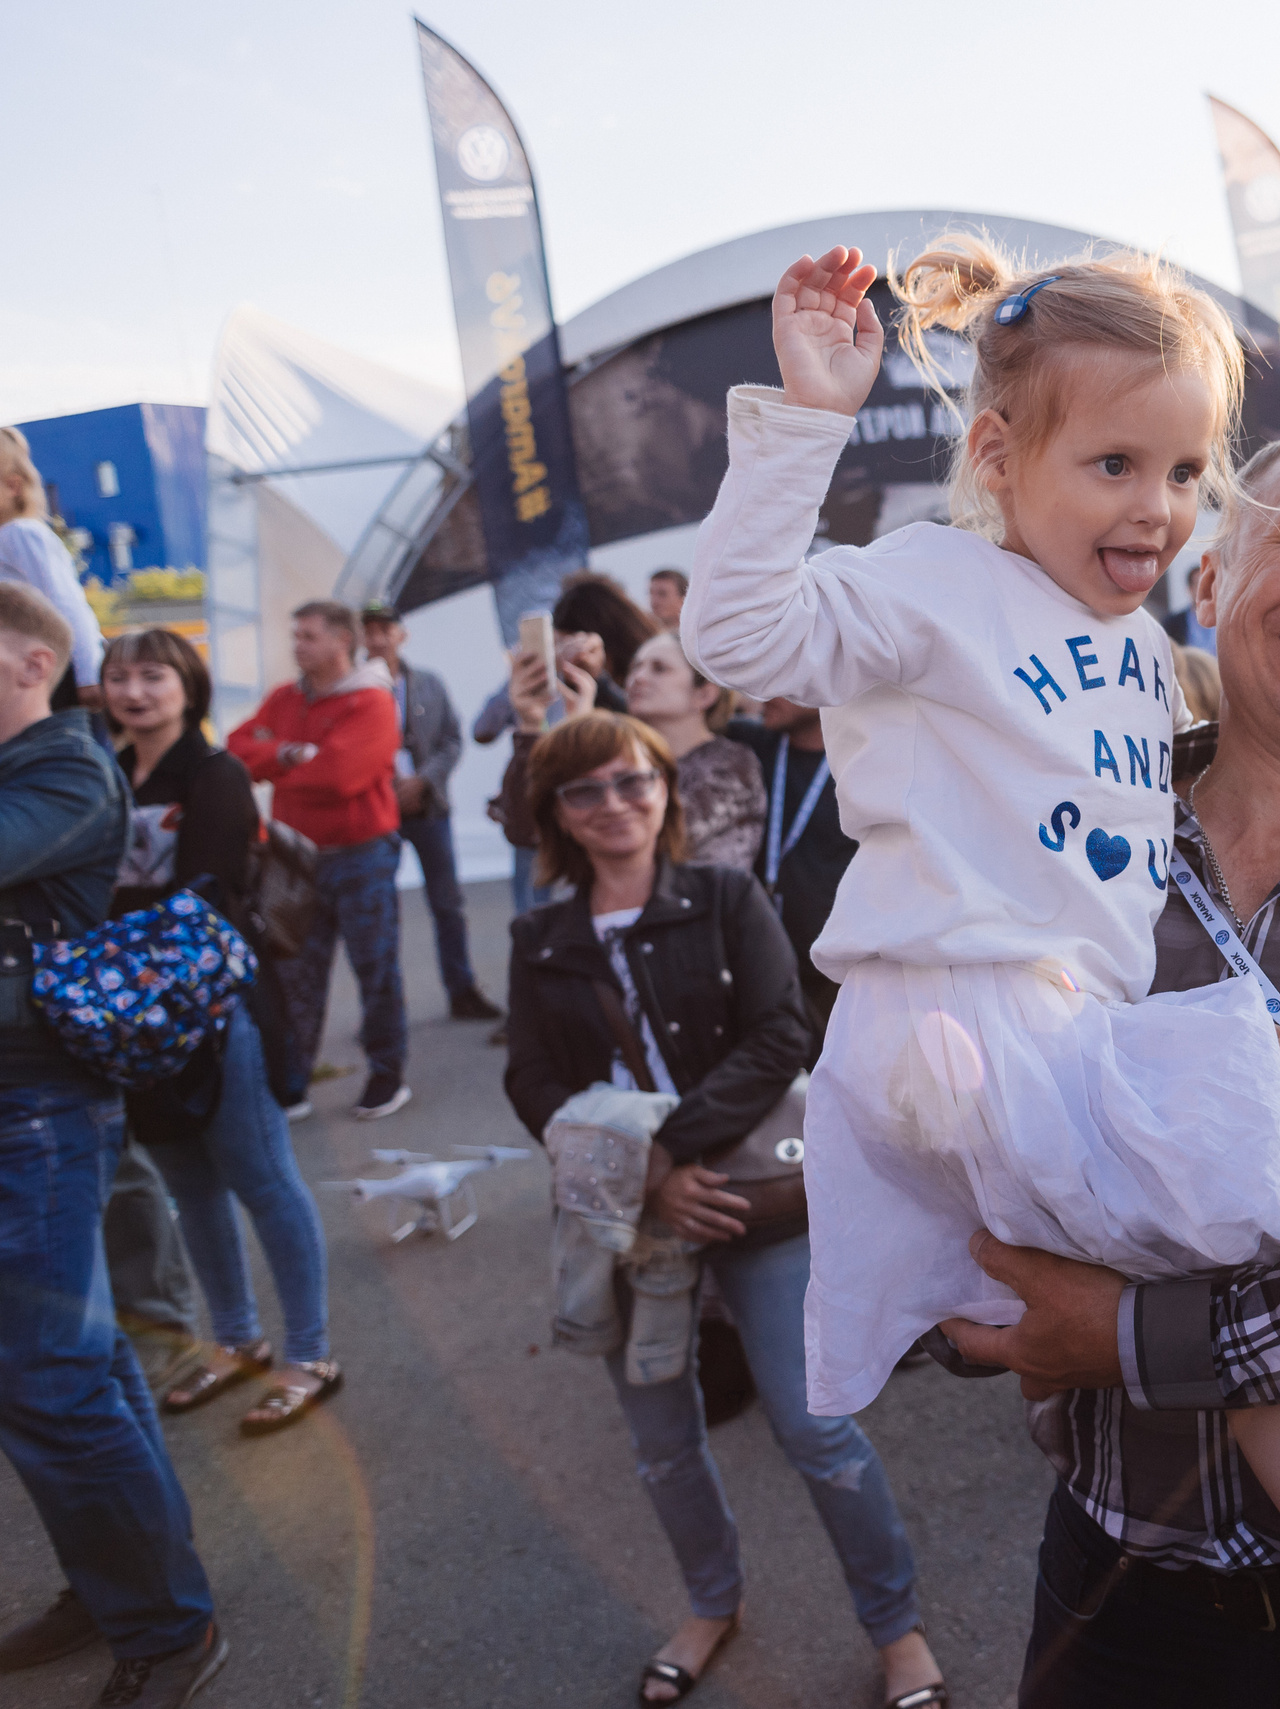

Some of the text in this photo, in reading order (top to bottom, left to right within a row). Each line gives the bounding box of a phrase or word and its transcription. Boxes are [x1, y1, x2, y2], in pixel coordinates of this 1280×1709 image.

[1013, 635, 1170, 715] HEAR
[1094, 729, 1171, 793] AND
[1190, 891, 1215, 922] AMAROK
